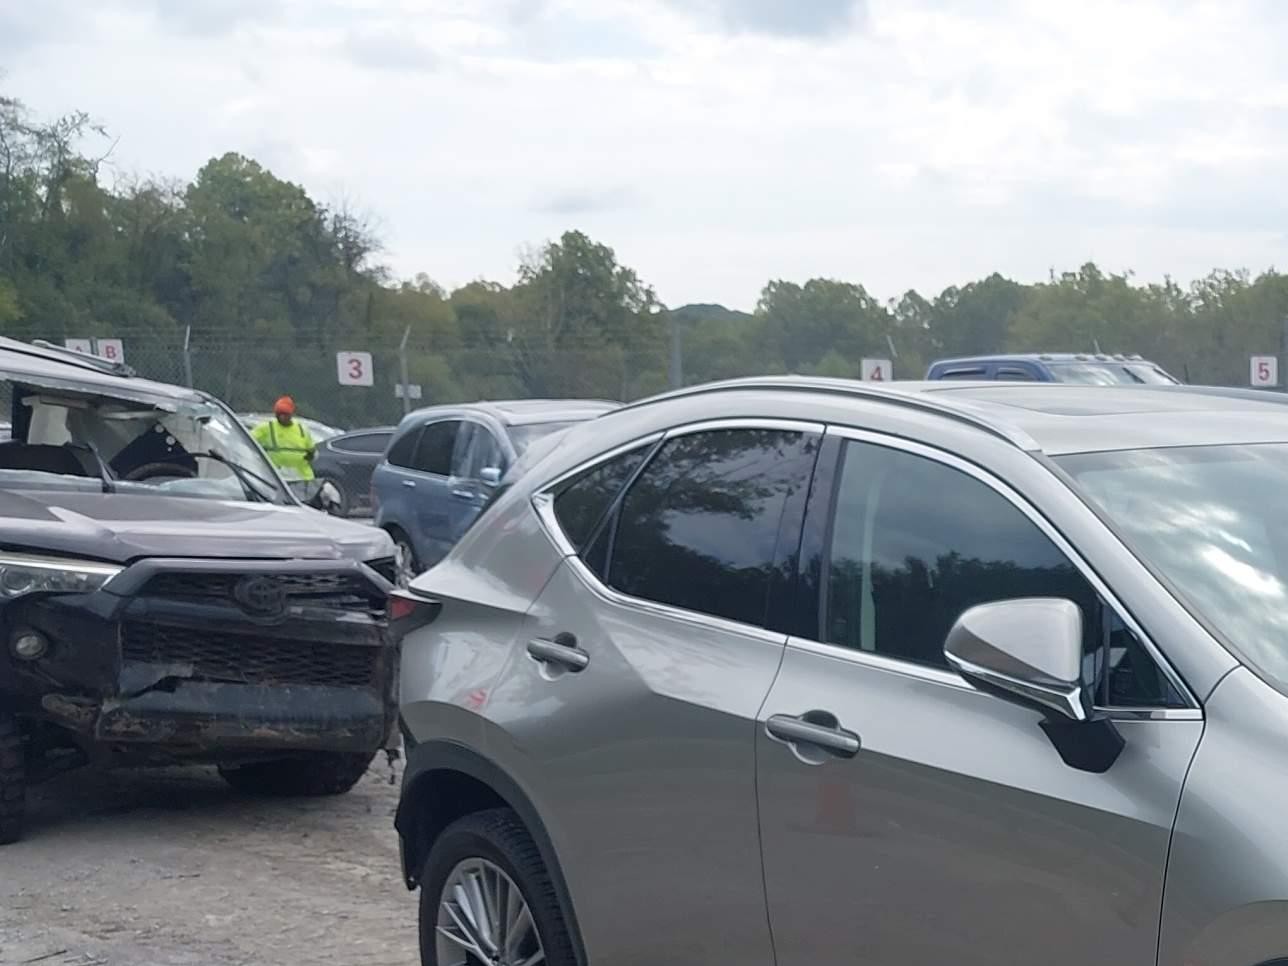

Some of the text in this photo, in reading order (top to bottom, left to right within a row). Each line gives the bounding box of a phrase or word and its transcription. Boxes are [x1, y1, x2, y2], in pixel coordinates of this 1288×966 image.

[105, 345, 117, 359] B
[348, 358, 363, 380] 3
[871, 366, 883, 381] 4
[1258, 362, 1270, 381] 5
